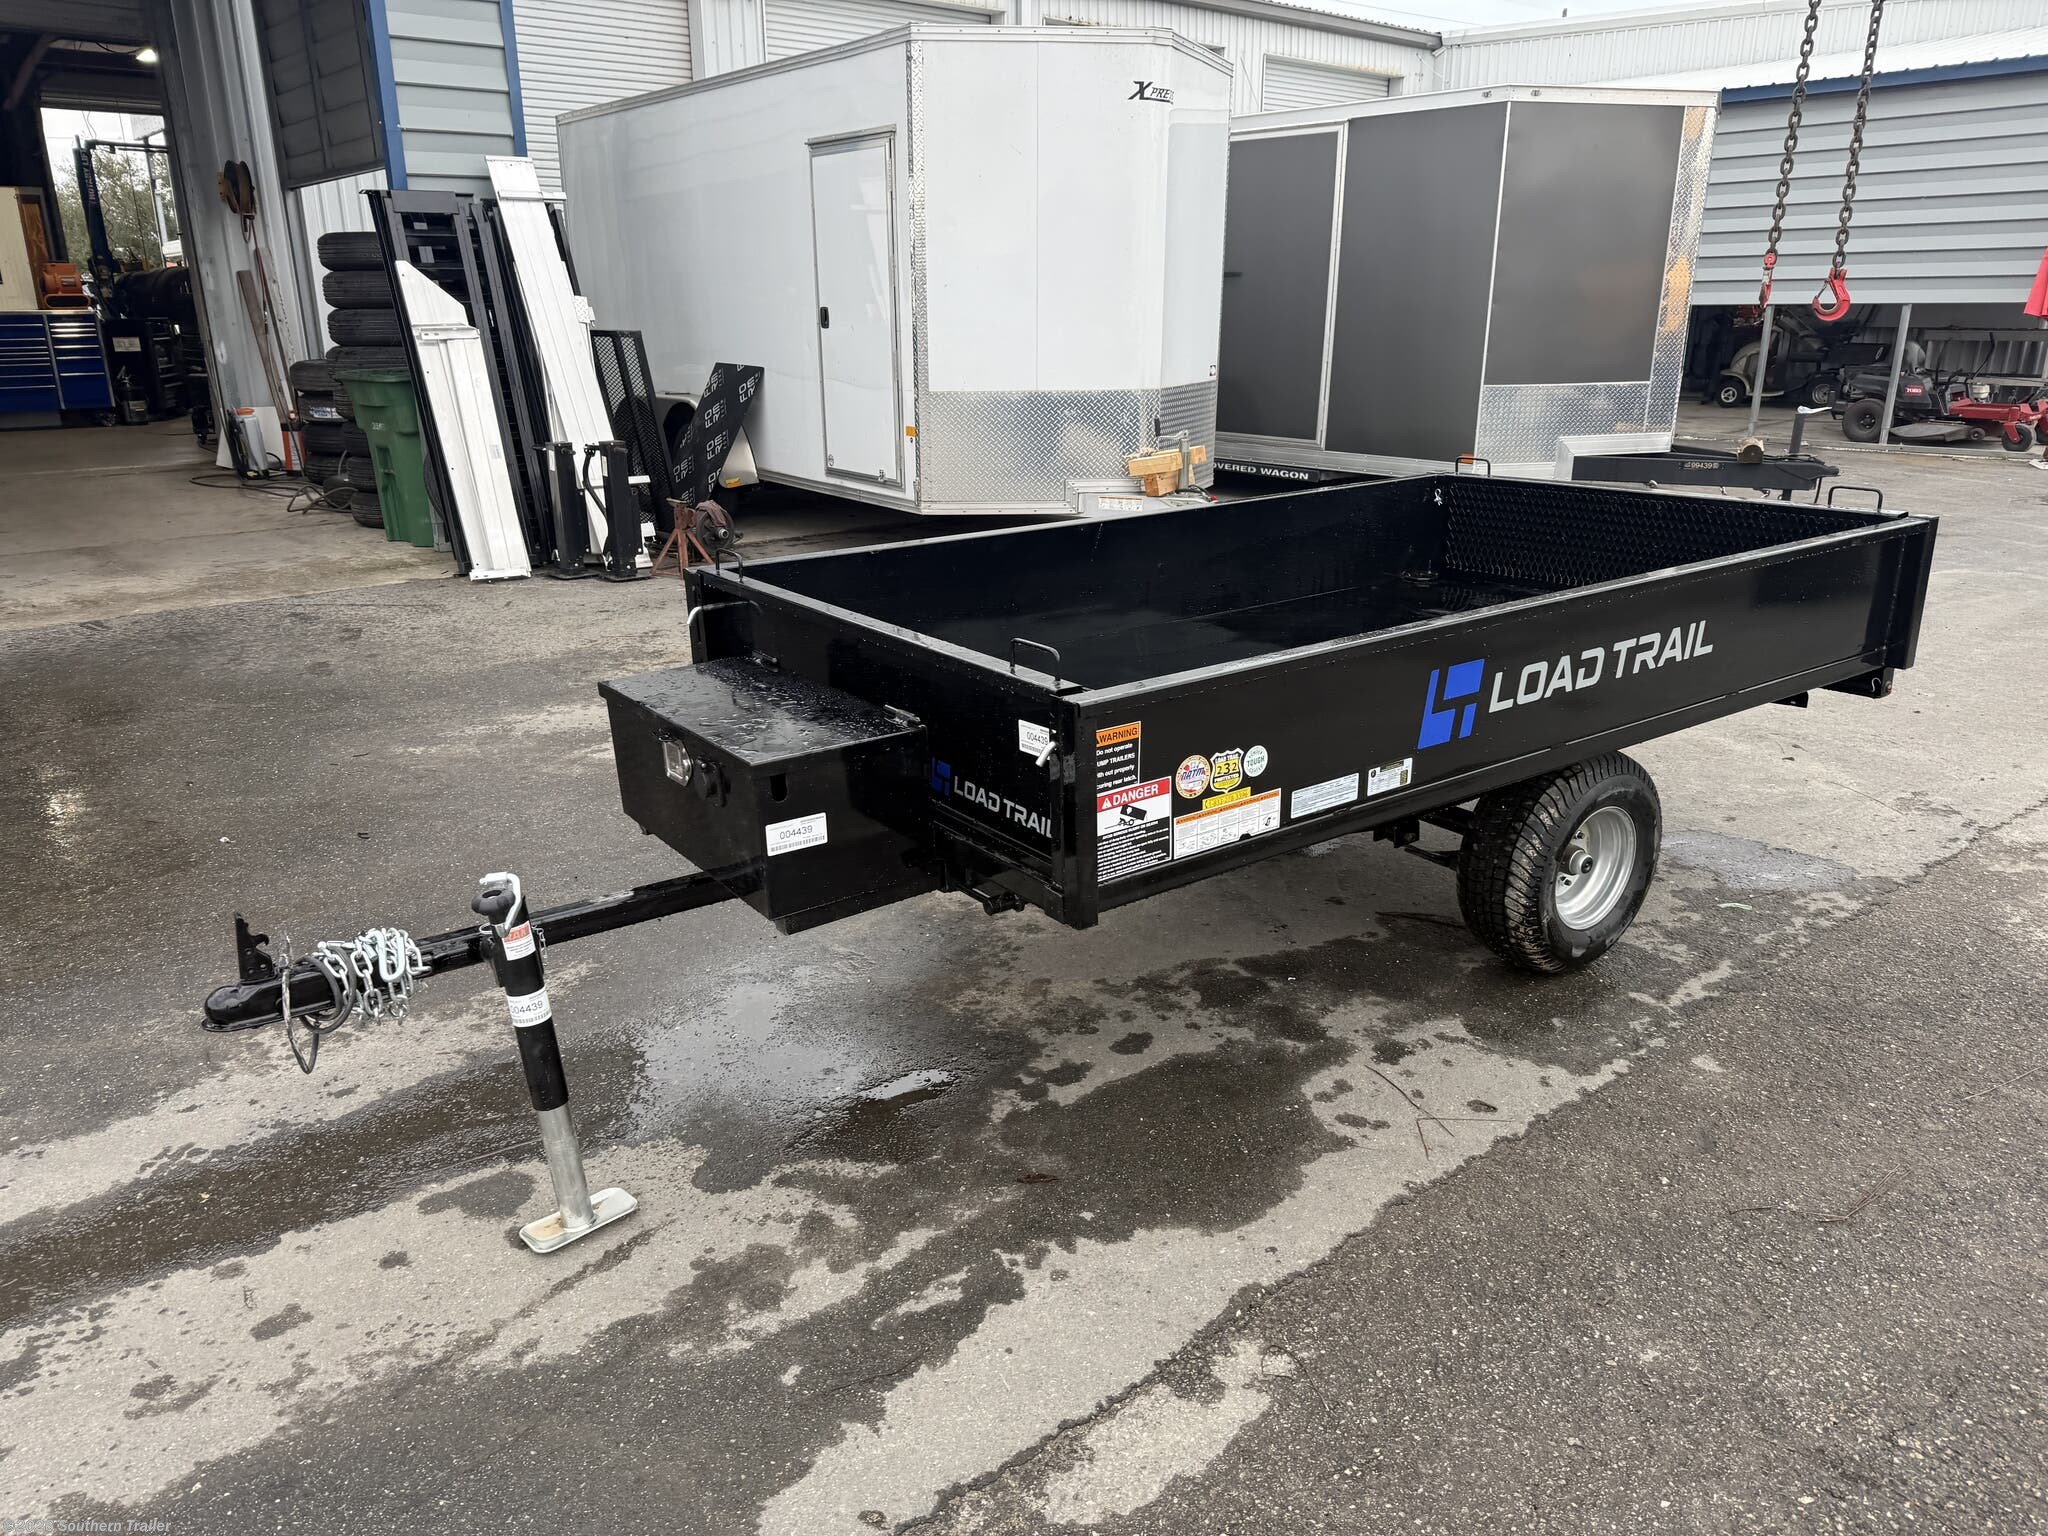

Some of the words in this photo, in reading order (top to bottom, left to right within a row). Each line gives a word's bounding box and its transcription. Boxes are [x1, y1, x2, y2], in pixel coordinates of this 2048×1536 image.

[1260, 467, 1309, 480] WAGON
[1488, 647, 1605, 713] LOAD
[1613, 620, 1714, 679] TRAIL
[1099, 727, 1138, 743] WARNING
[1096, 759, 1109, 767] UMP
[1216, 762, 1237, 775] 232
[1112, 784, 1159, 806] DANGER
[954, 775, 1000, 813] LOAD
[1003, 798, 1052, 838] TRAIL
[779, 825, 813, 840] 004439
